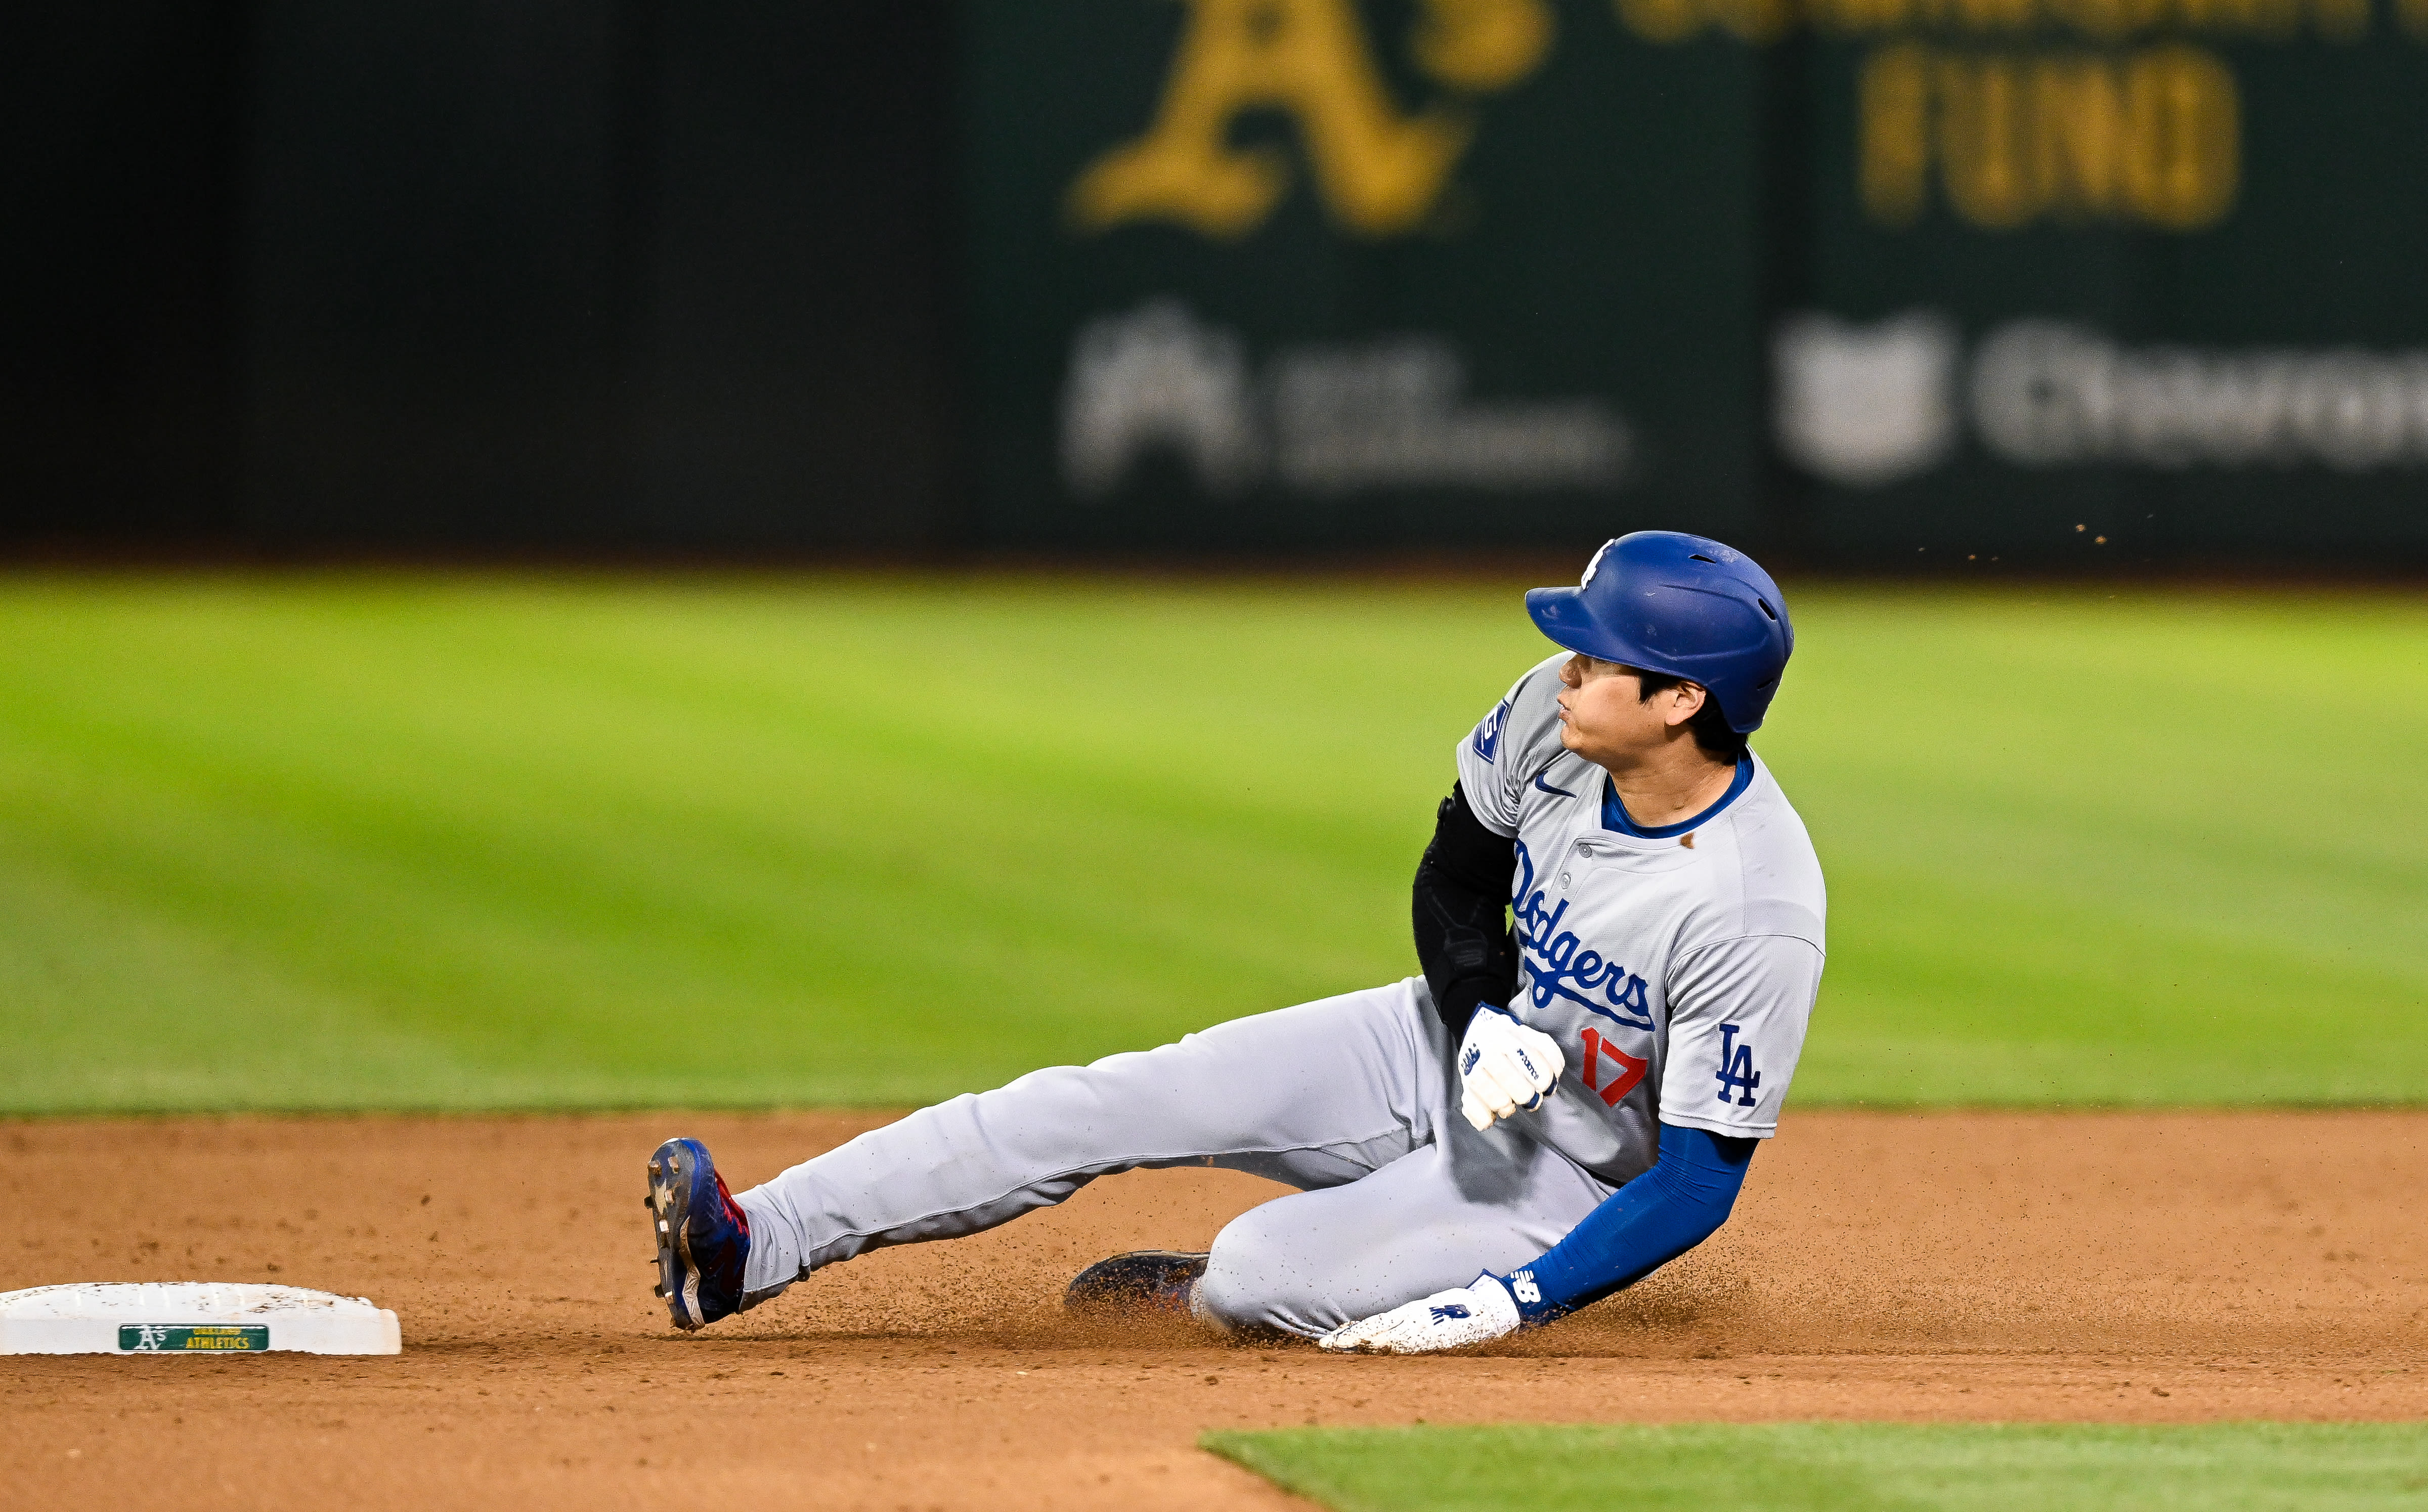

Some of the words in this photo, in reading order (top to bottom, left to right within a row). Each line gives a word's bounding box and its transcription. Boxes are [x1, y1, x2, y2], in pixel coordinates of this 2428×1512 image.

[1859, 45, 2240, 230] FUND
[1512, 839, 1656, 1032] Dodgers
[1580, 1027, 1648, 1107] 17
[1715, 1023, 1761, 1107] LA
[185, 1337, 250, 1349] ATHLETICS
